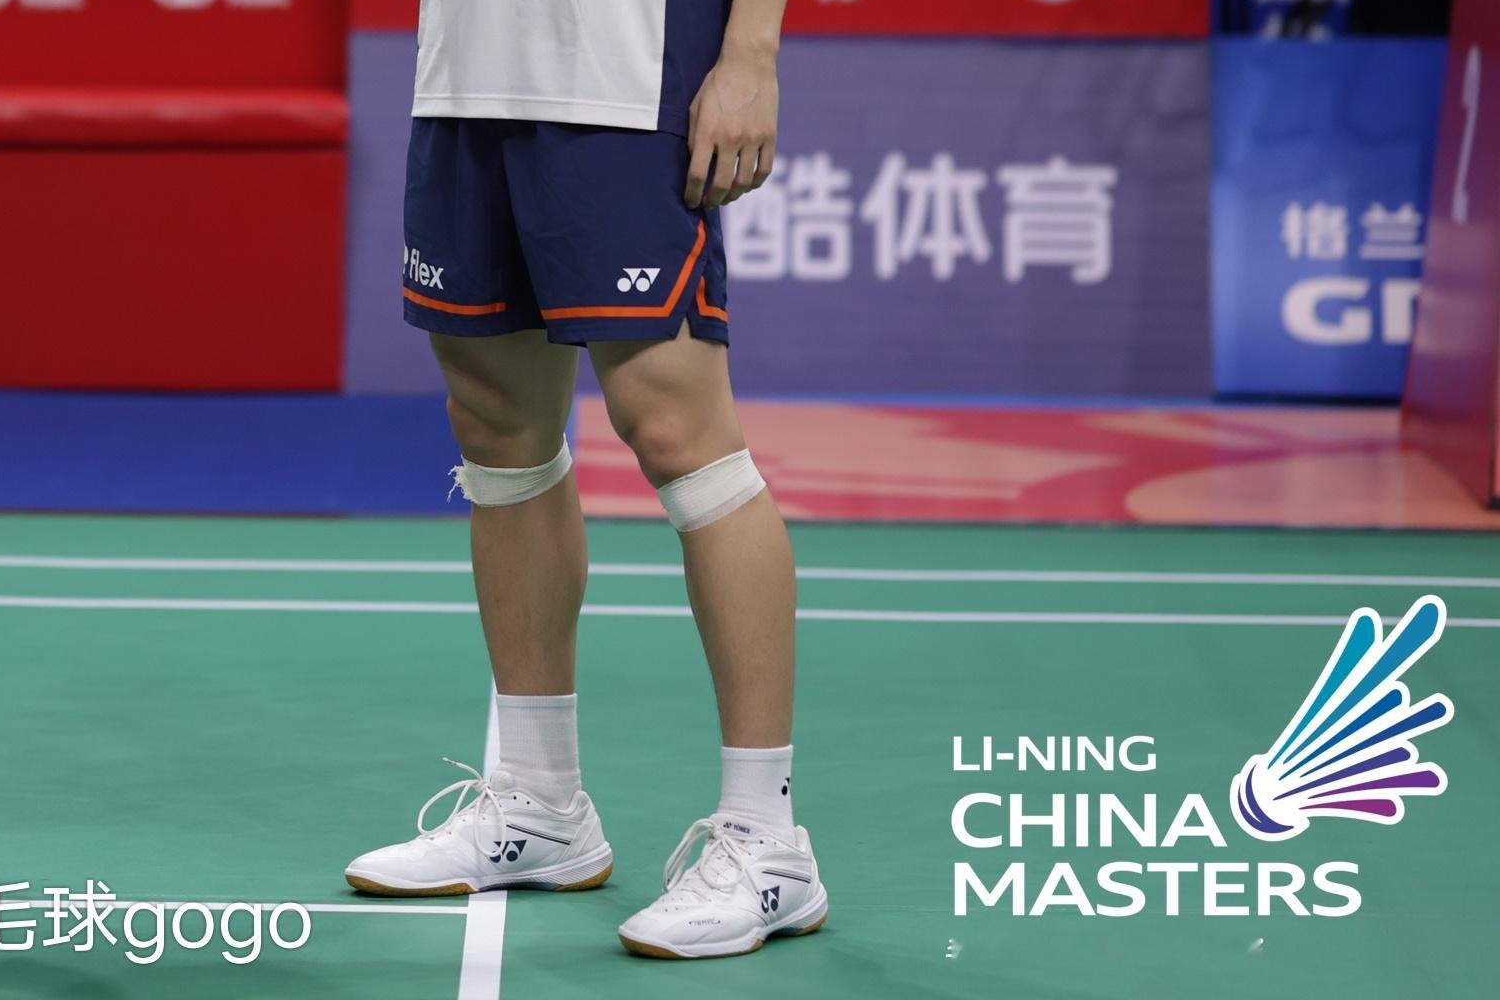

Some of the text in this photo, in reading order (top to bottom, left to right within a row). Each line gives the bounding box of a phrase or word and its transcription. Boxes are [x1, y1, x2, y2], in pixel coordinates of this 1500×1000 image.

[723, 152, 1118, 284] 酷体育
[409, 248, 444, 290] flex
